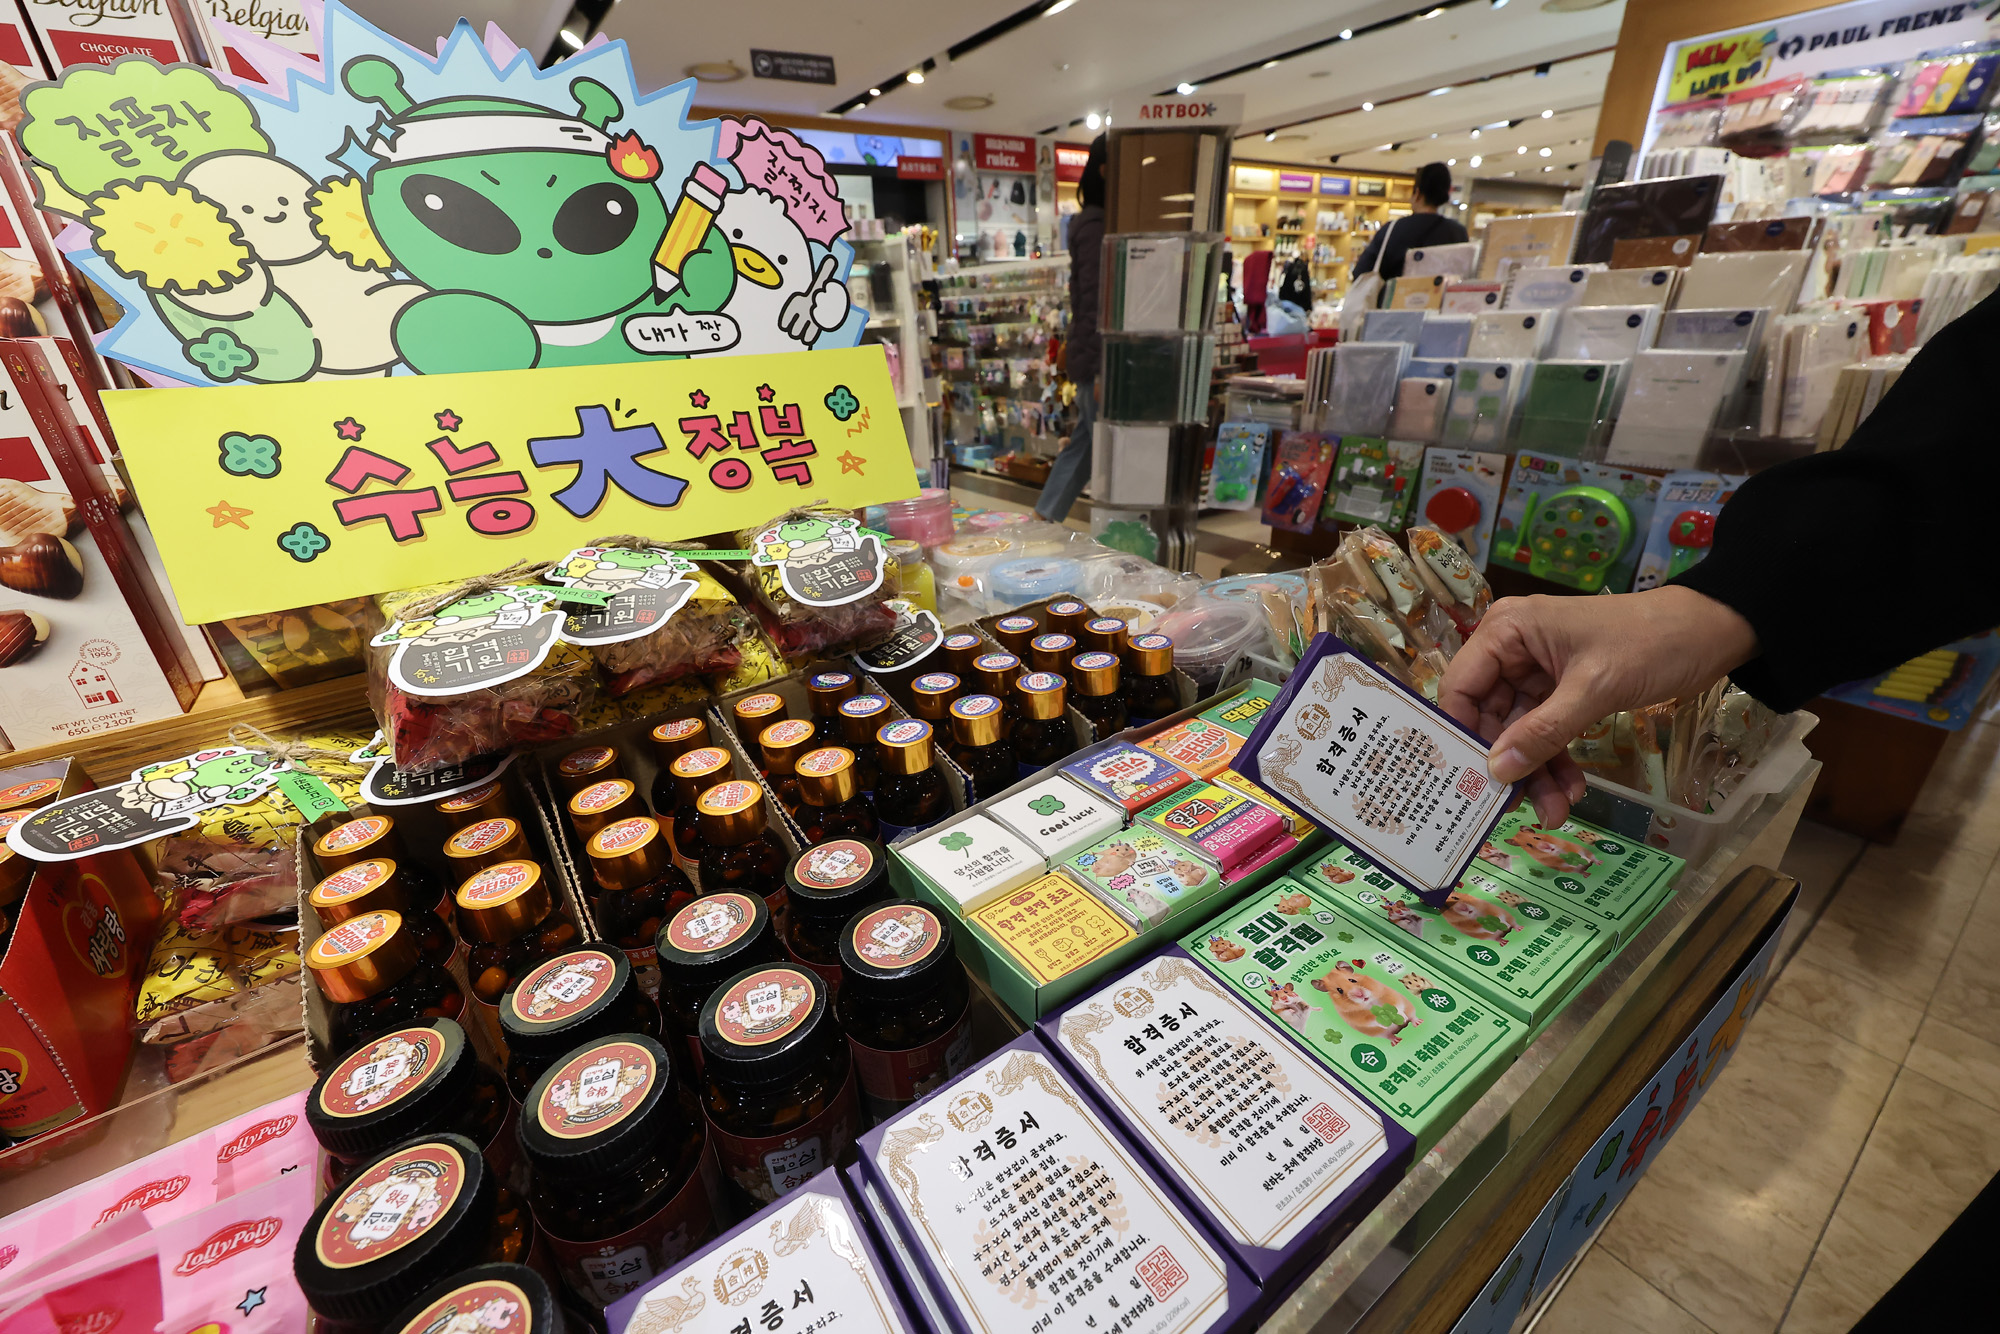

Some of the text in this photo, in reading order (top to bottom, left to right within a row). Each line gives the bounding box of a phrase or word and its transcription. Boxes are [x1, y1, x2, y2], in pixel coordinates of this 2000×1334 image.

[80, 42, 154, 58] CHOCOLATE
[1810, 3, 1967, 52] PAUL FRENZ
[1686, 42, 1738, 71] NEW
[54, 97, 212, 167] 잘풀자
[1139, 102, 1216, 119] ARTBOX
[766, 150, 828, 225] 잘찍자
[638, 319, 722, 344] 내가 짱
[326, 436, 536, 543] 수능
[680, 403, 817, 489] 정복
[811, 561, 844, 580] 합격
[820, 574, 858, 590] 기원
[590, 609, 634, 627] 기원
[442, 639, 500, 661] 합격
[446, 655, 504, 673] 기원
[51, 708, 138, 731] NET WT. CONT. NET.
[68, 726, 90, 736] 65G
[1039, 819, 1069, 835] Good
[1068, 806, 1096, 822] luck!
[1166, 799, 1217, 830] 합격
[953, 859, 982, 876] 당신의
[981, 846, 1010, 861] 합격을
[962, 853, 1014, 879] 기원합니다!
[1561, 843, 1619, 890] 合 格
[996, 887, 1073, 931] 합격 부적 초코
[1237, 911, 1287, 944] 절대
[1253, 923, 1323, 970] 합격햄
[1474, 906, 1543, 961] 合 格
[1290, 948, 1341, 983] 합격길만 걸어요
[1123, 1002, 1197, 1055] 합격증서
[1135, 1019, 1223, 1078] 위 사람은 밤낮없이 공부하고,
[1360, 993, 1449, 1066] 合 格
[1379, 1006, 1484, 1095] 합격햄! 축하햄! 행복햄!
[1158, 1040, 1260, 1113] 누구보다 뛰어난 실력을 갖췄으며,
[1159, 1034, 1220, 1077] 남다른 노력과 집념,
[1167, 1042, 1232, 1089] 뜨거운 열정과 열의로
[585, 1086, 609, 1098] 合格
[1168, 1049, 1271, 1124] 매시간 노력과 최선을 다했습니다.
[1184, 1061, 1276, 1131] 평소보다 더 높은 점수를 받아
[1207, 1080, 1275, 1134] 틀림없이 원하는 곳에
[1219, 1093, 1311, 1166] 미리 이 합격증을 수여합니다.
[1228, 1095, 1280, 1138] 합격할 것이기에
[995, 1133, 1066, 1183] 밤낮없이 공부하고,
[1262, 1136, 1323, 1191] 원하는 곳에 합격하장
[1265, 1124, 1310, 1161] 년 월 일
[982, 1154, 1059, 1212] 남다른 노력과 집념,
[989, 1164, 1071, 1228] 뜨거운 열정과 열의로
[1031, 1233, 1150, 1334] 미리 이 합격증을 수여합니다.
